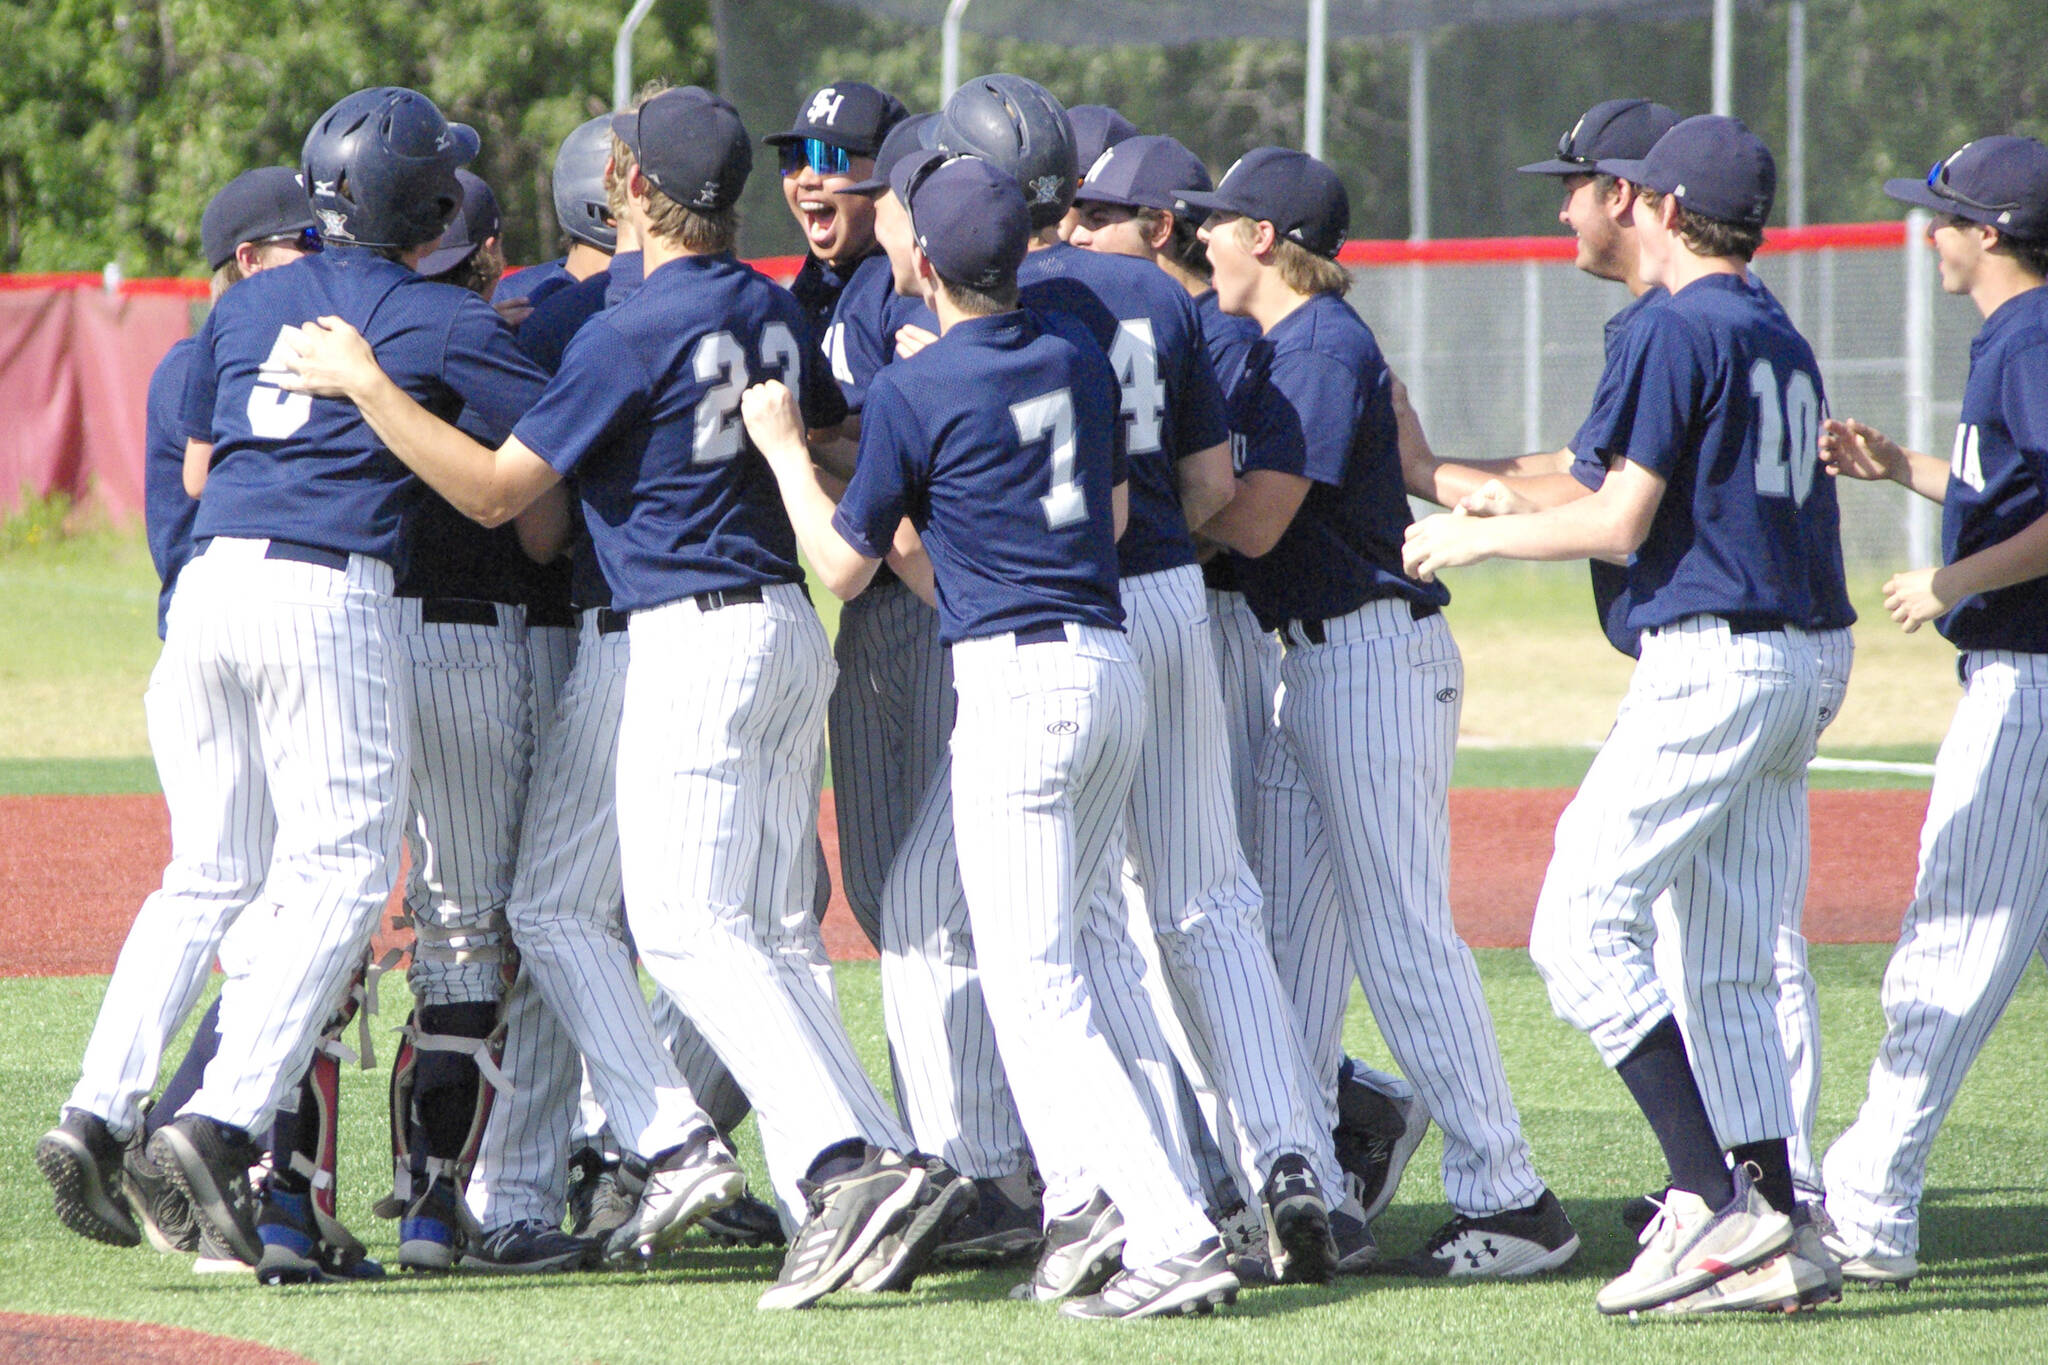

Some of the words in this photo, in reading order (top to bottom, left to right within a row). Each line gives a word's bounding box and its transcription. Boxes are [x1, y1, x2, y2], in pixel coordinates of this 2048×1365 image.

[1008, 386, 1090, 532] 7
[1107, 318, 1166, 455] 4
[1750, 357, 1819, 509] 10
